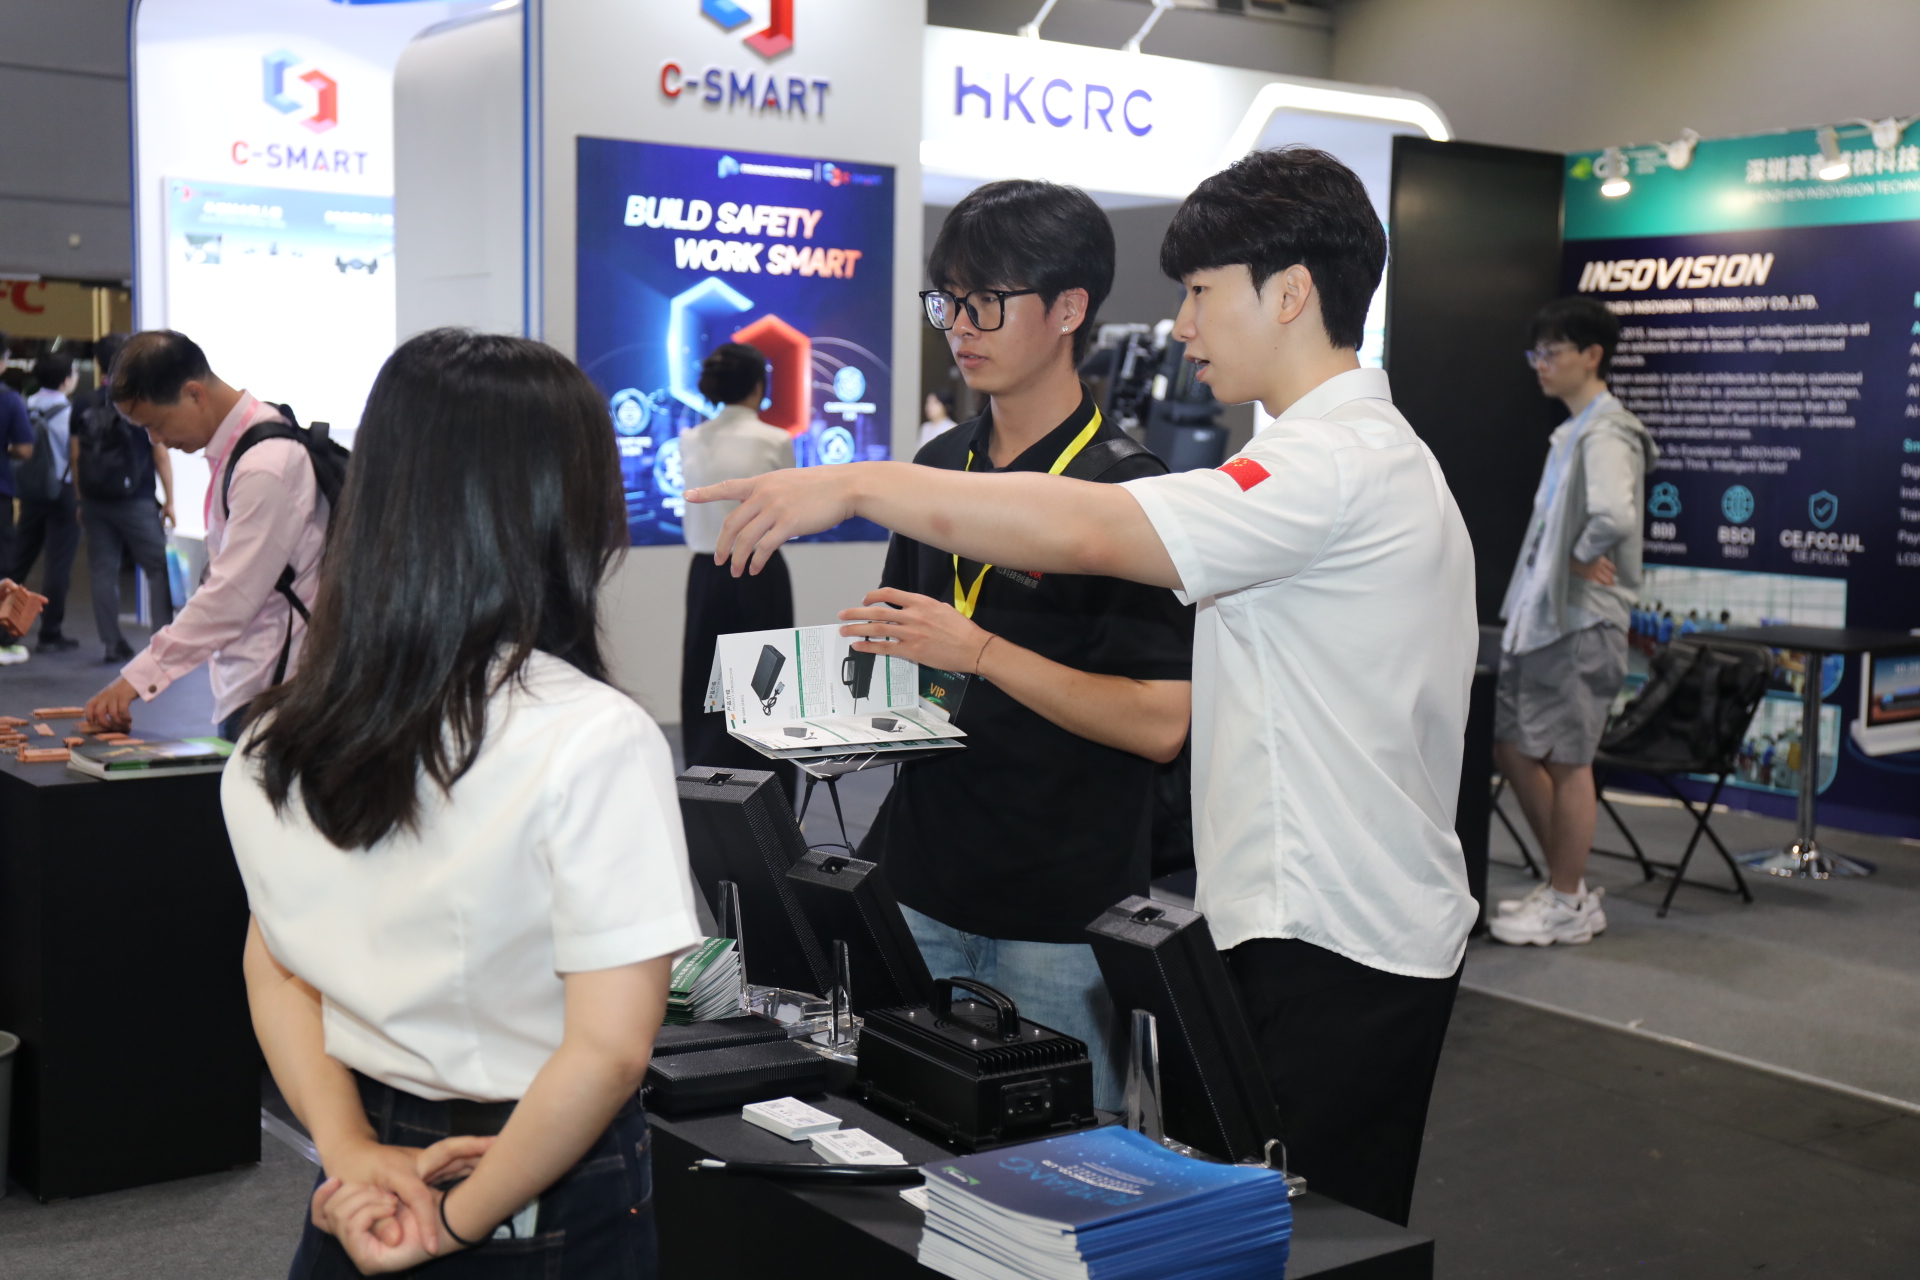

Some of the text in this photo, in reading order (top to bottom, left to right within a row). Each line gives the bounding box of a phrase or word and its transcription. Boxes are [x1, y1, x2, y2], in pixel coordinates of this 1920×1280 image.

[661, 63, 829, 114] C-SMART
[231, 141, 368, 175] C-SMART
[624, 194, 823, 239] BUILD SAFETY
[674, 237, 863, 279] WORK SMART
[1578, 252, 1774, 292] INSOVISION
[1693, 296, 1768, 313] TECHNOLOGY
[1717, 525, 1756, 546] BSCI
[930, 682, 946, 699] VIP
